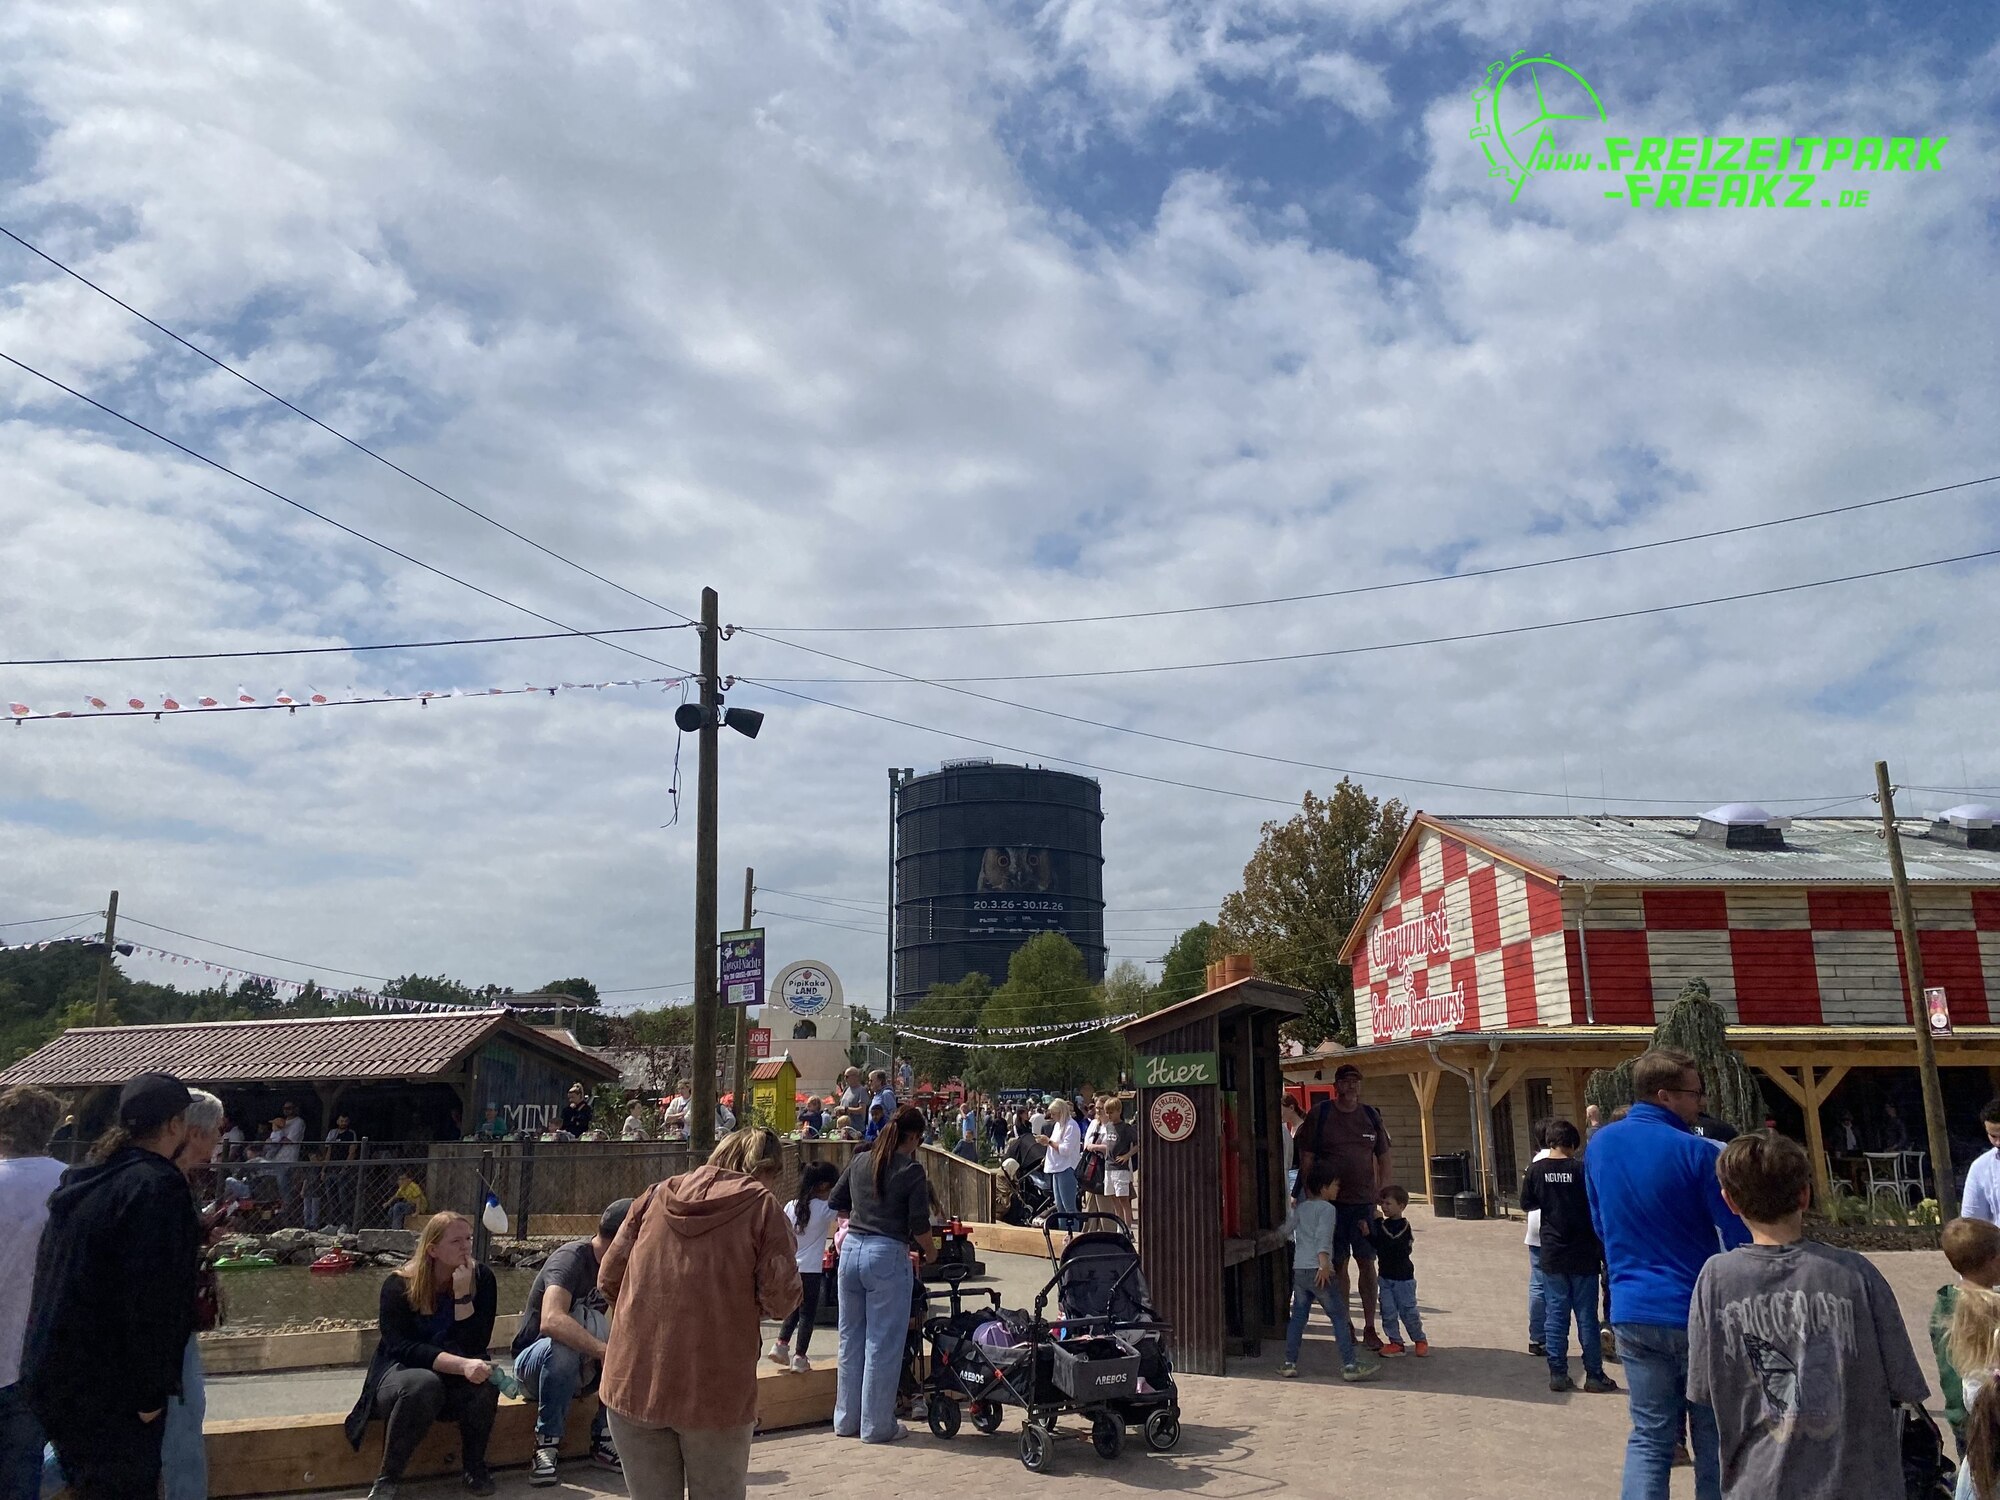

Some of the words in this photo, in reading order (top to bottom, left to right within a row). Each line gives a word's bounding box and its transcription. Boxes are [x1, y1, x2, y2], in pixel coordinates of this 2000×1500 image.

[795, 987, 818, 995] LAND
[1408, 980, 1466, 1032] Bratwurst
[1145, 1056, 1210, 1085] Hier
[1158, 1096, 1188, 1110] ERLEBNIS
[1544, 1172, 1573, 1183] NGUYEN
[959, 1369, 985, 1385] AREBOS
[1095, 1372, 1128, 1386] AREBOS
